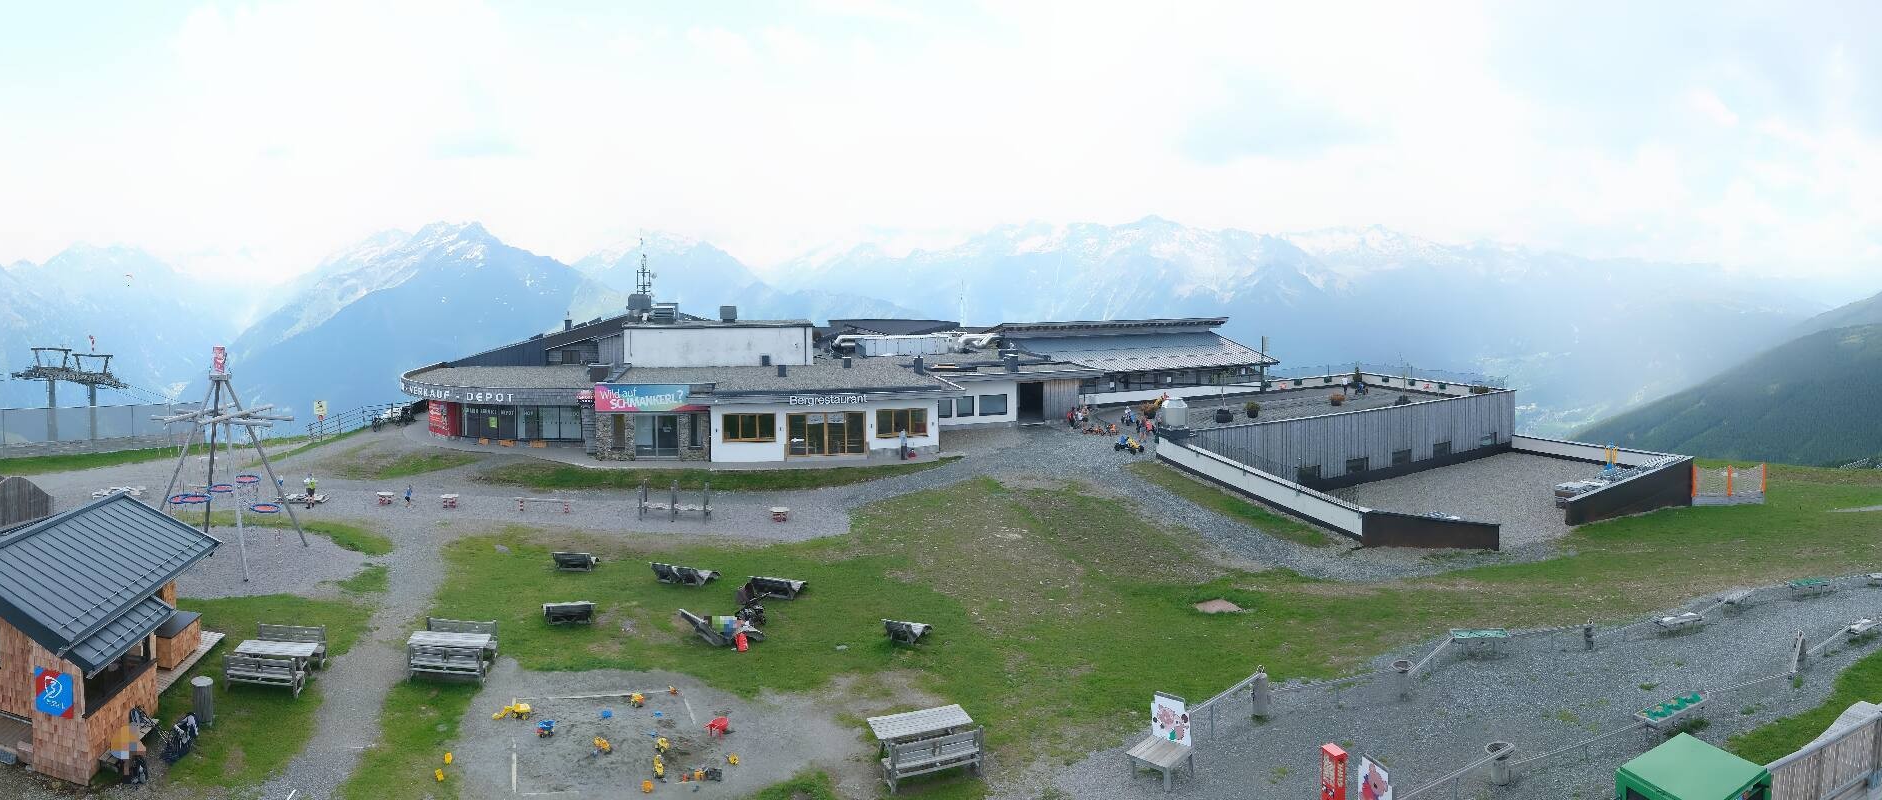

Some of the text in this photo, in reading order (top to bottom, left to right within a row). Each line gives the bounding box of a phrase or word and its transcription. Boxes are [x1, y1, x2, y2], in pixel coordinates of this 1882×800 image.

[409, 386, 450, 399] VERKAUF
[466, 392, 514, 402] DEPOT
[599, 388, 620, 400] Wild
[622, 387, 637, 398] auf
[609, 389, 684, 409] SCHMANKERL?
[789, 394, 868, 406] Bergrestaurant
